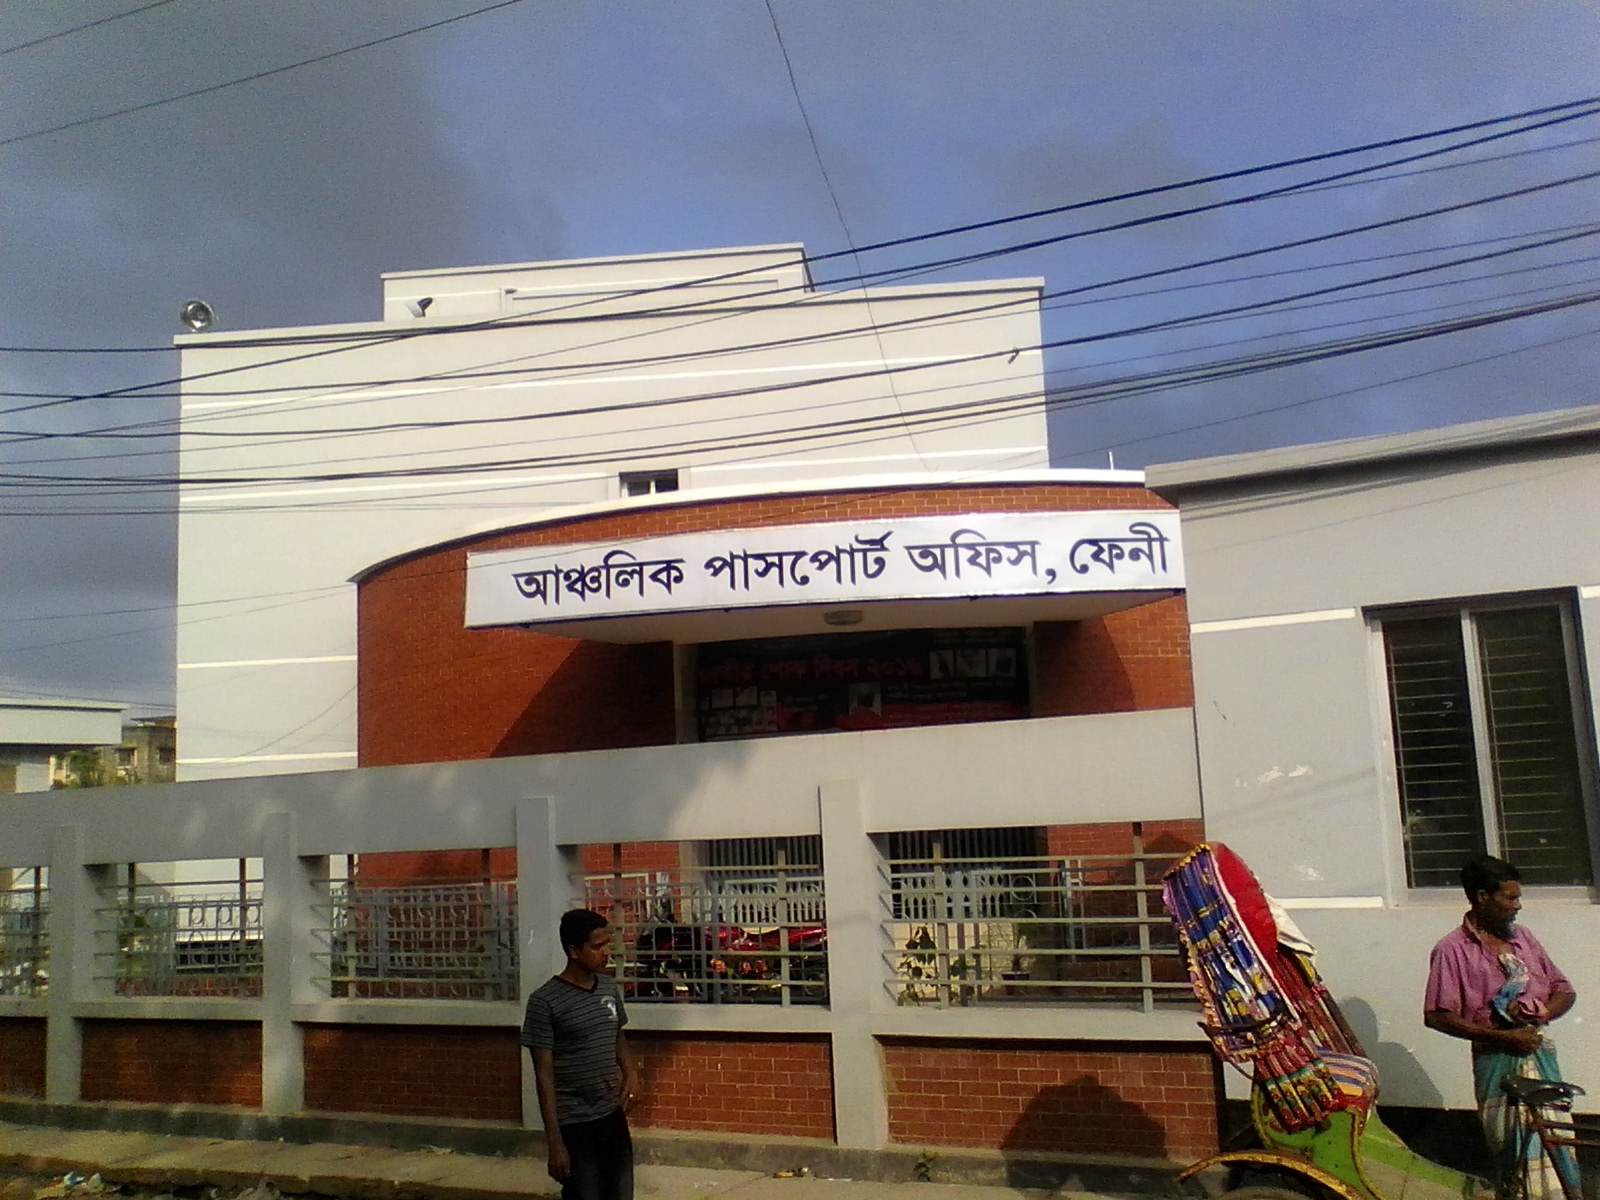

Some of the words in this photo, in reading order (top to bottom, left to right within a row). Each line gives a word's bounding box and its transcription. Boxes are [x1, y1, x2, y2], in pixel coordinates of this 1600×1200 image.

[511, 549, 686, 605] আঞ্চলিক
[703, 530, 892, 592] পাসপোর্ট
[906, 527, 1057, 584] অফিস,
[1070, 522, 1168, 576] ফেনী
